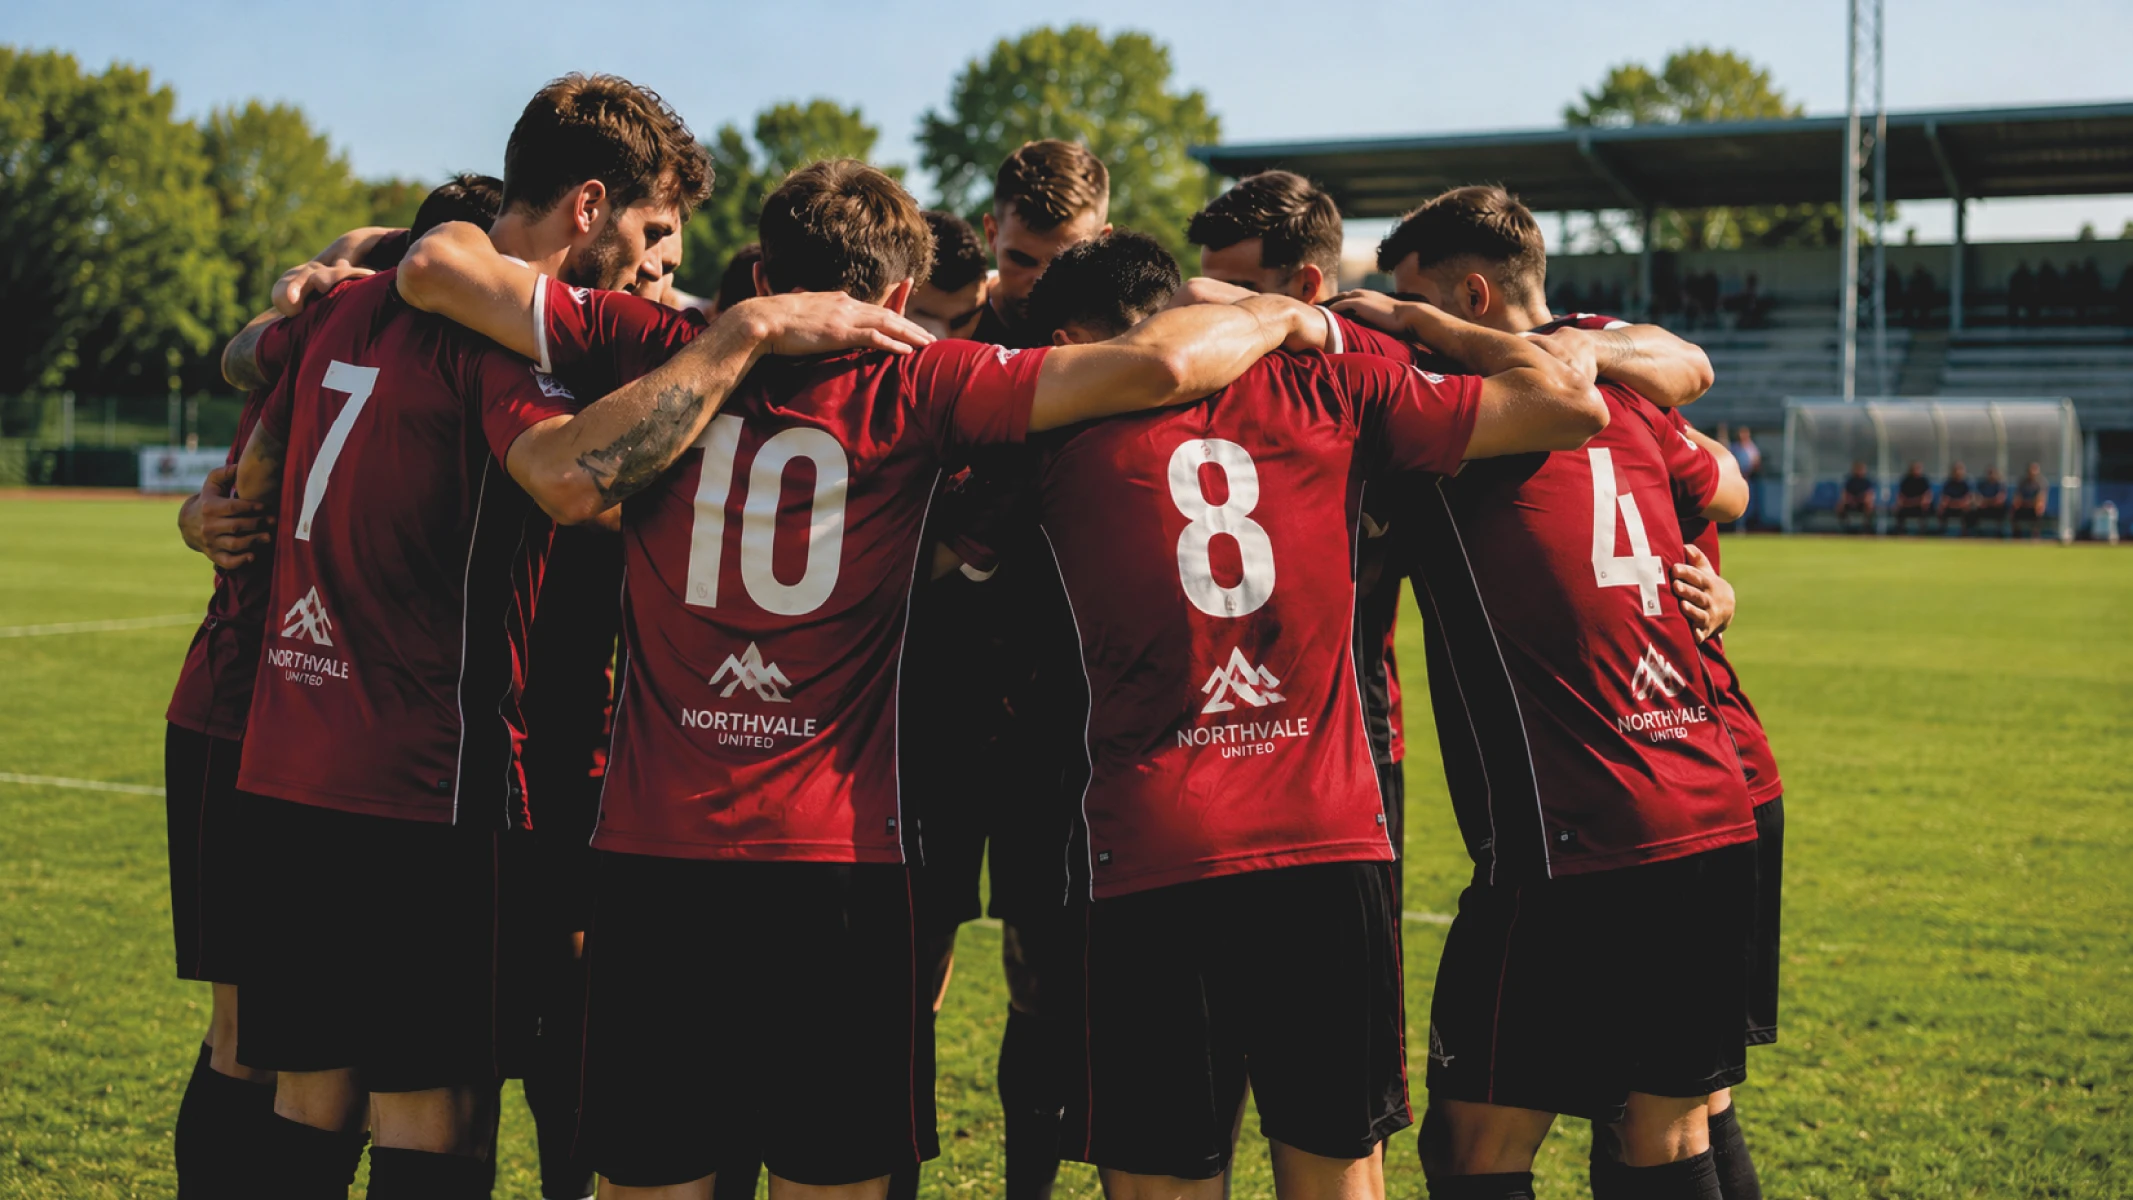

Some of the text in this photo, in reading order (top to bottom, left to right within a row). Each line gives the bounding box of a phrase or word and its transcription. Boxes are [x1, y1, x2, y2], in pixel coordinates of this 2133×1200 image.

[295, 360, 380, 541] 7
[685, 413, 849, 616] 10
[1167, 438, 1276, 618] 8
[1588, 447, 1666, 616] 4
[268, 648, 348, 679] NORTHVALE
[285, 670, 323, 686] UNITED
[681, 708, 816, 737] NORTHVALE
[1177, 717, 1309, 748] NORTHVALE
[718, 733, 774, 749] UNITED
